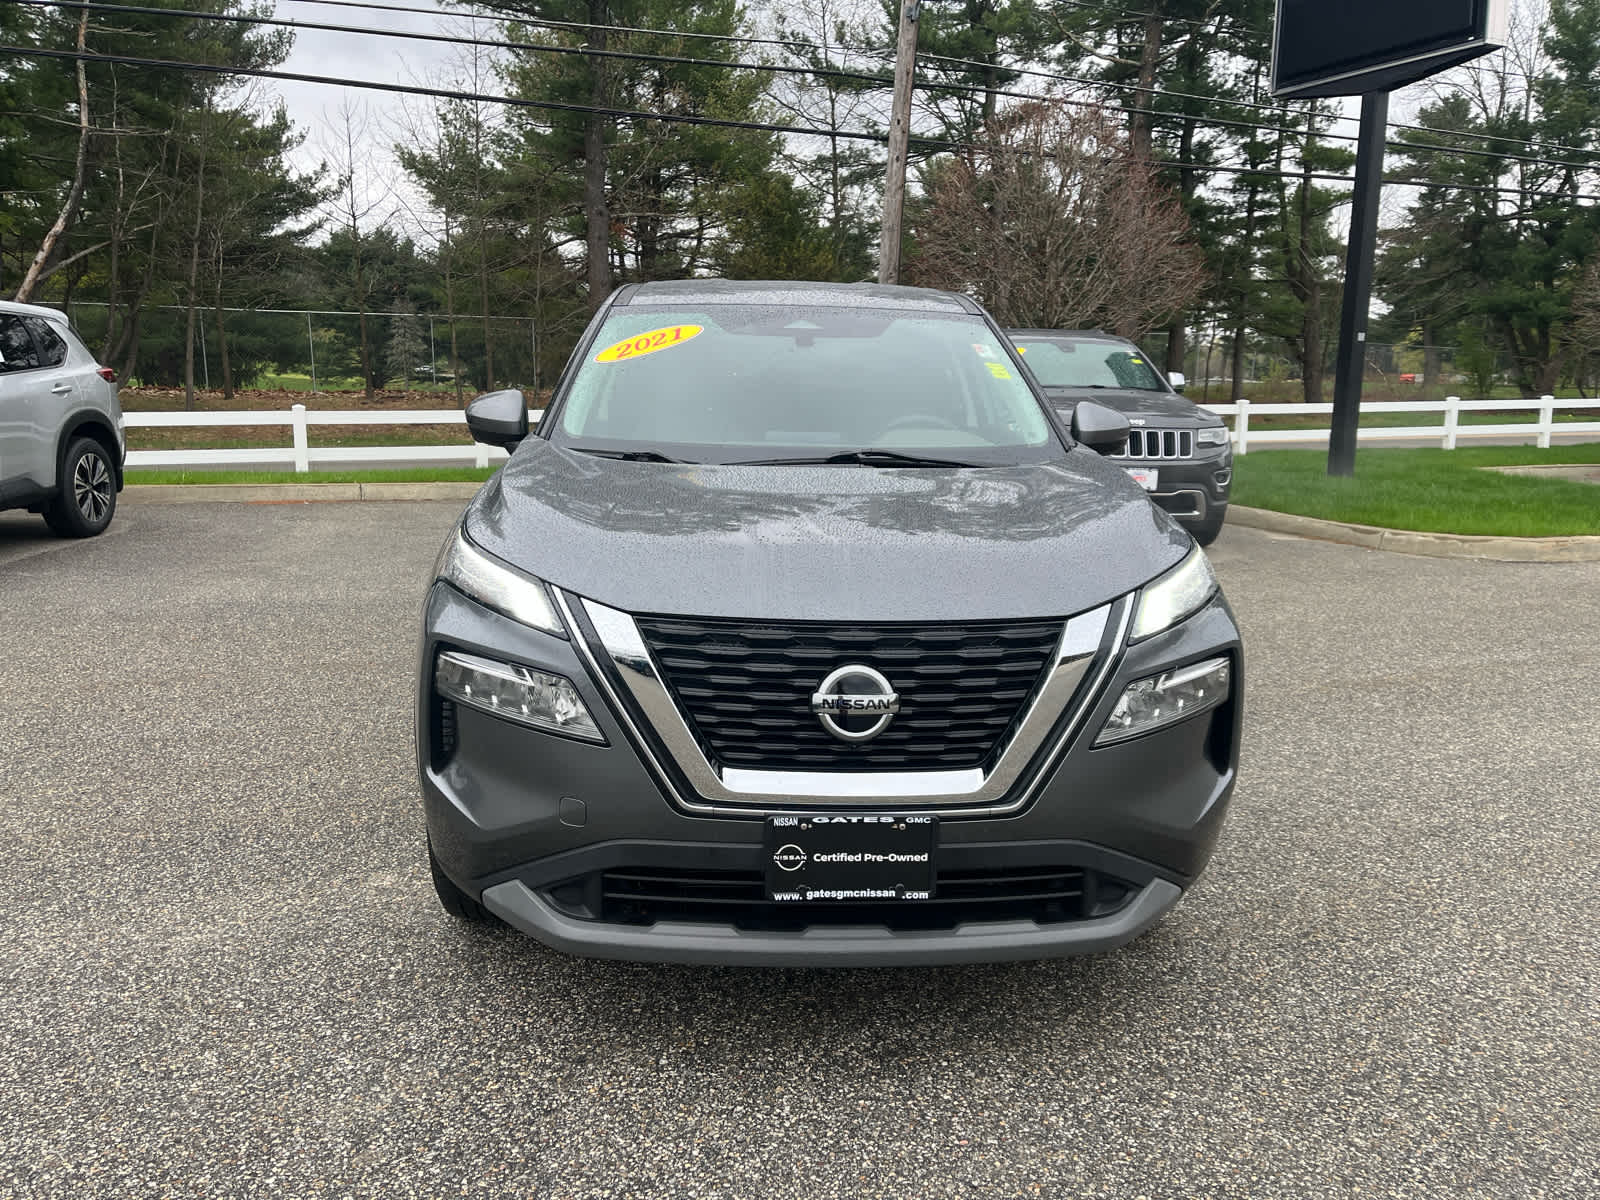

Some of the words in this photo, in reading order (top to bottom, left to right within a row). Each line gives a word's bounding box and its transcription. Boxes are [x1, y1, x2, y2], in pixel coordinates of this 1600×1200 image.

[616, 327, 682, 359] 2021
[822, 698, 890, 710] NISSAN
[773, 817, 798, 826] NISSAN
[813, 853, 862, 862] Certified
[864, 853, 928, 862] Pre-Owned
